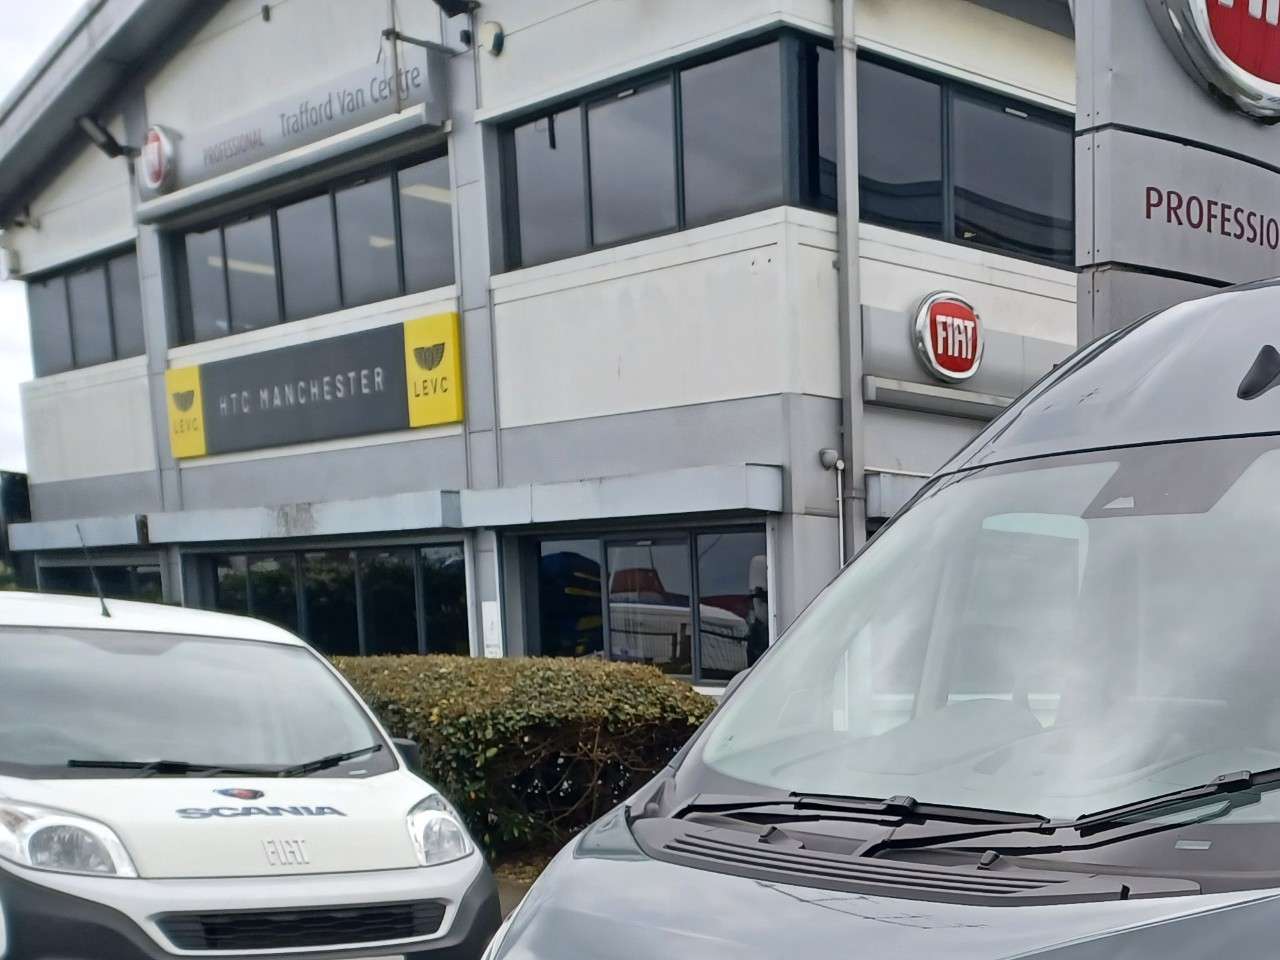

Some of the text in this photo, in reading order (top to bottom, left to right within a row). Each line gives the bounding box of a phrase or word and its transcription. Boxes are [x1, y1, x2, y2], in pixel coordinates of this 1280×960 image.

[280, 100, 333, 138] Trafford
[337, 87, 364, 114] Van
[935, 314, 975, 360] FIAT
[219, 367, 385, 416] HTC MANCHESTER
[413, 376, 449, 398] LEVC
[173, 417, 199, 434] LEVC
[175, 805, 348, 819] SCANIA
[261, 839, 310, 866] FIAT
